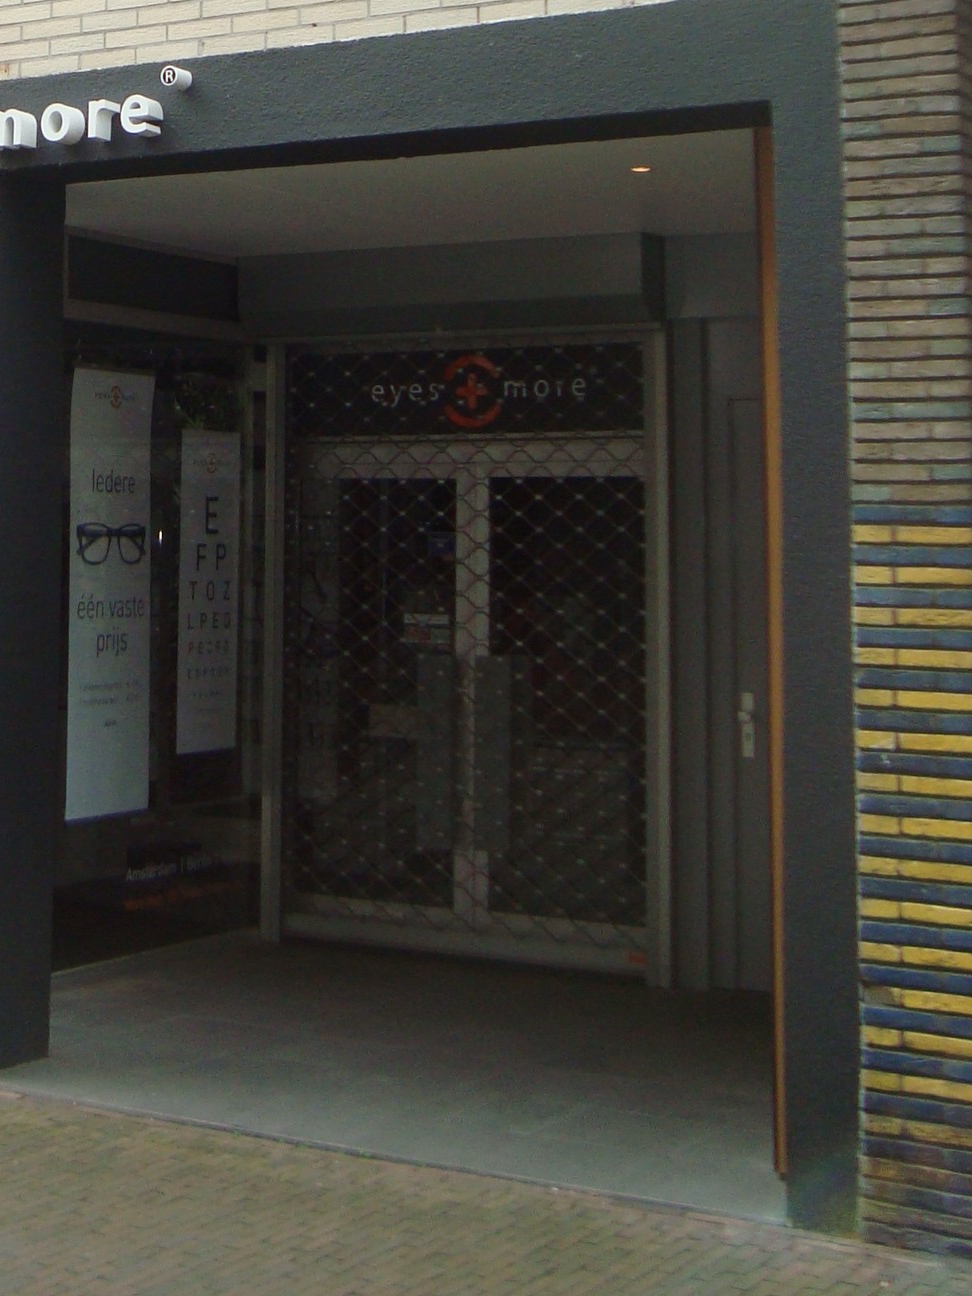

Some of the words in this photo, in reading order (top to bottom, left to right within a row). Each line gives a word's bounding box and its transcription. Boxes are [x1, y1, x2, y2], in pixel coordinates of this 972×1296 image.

[371, 382, 440, 407] eyes
[503, 376, 587, 399] more
[91, 467, 137, 494] Iedere
[205, 496, 220, 534] E
[76, 593, 105, 619] één
[109, 596, 146, 618] vaste
[96, 626, 129, 658] prijs
